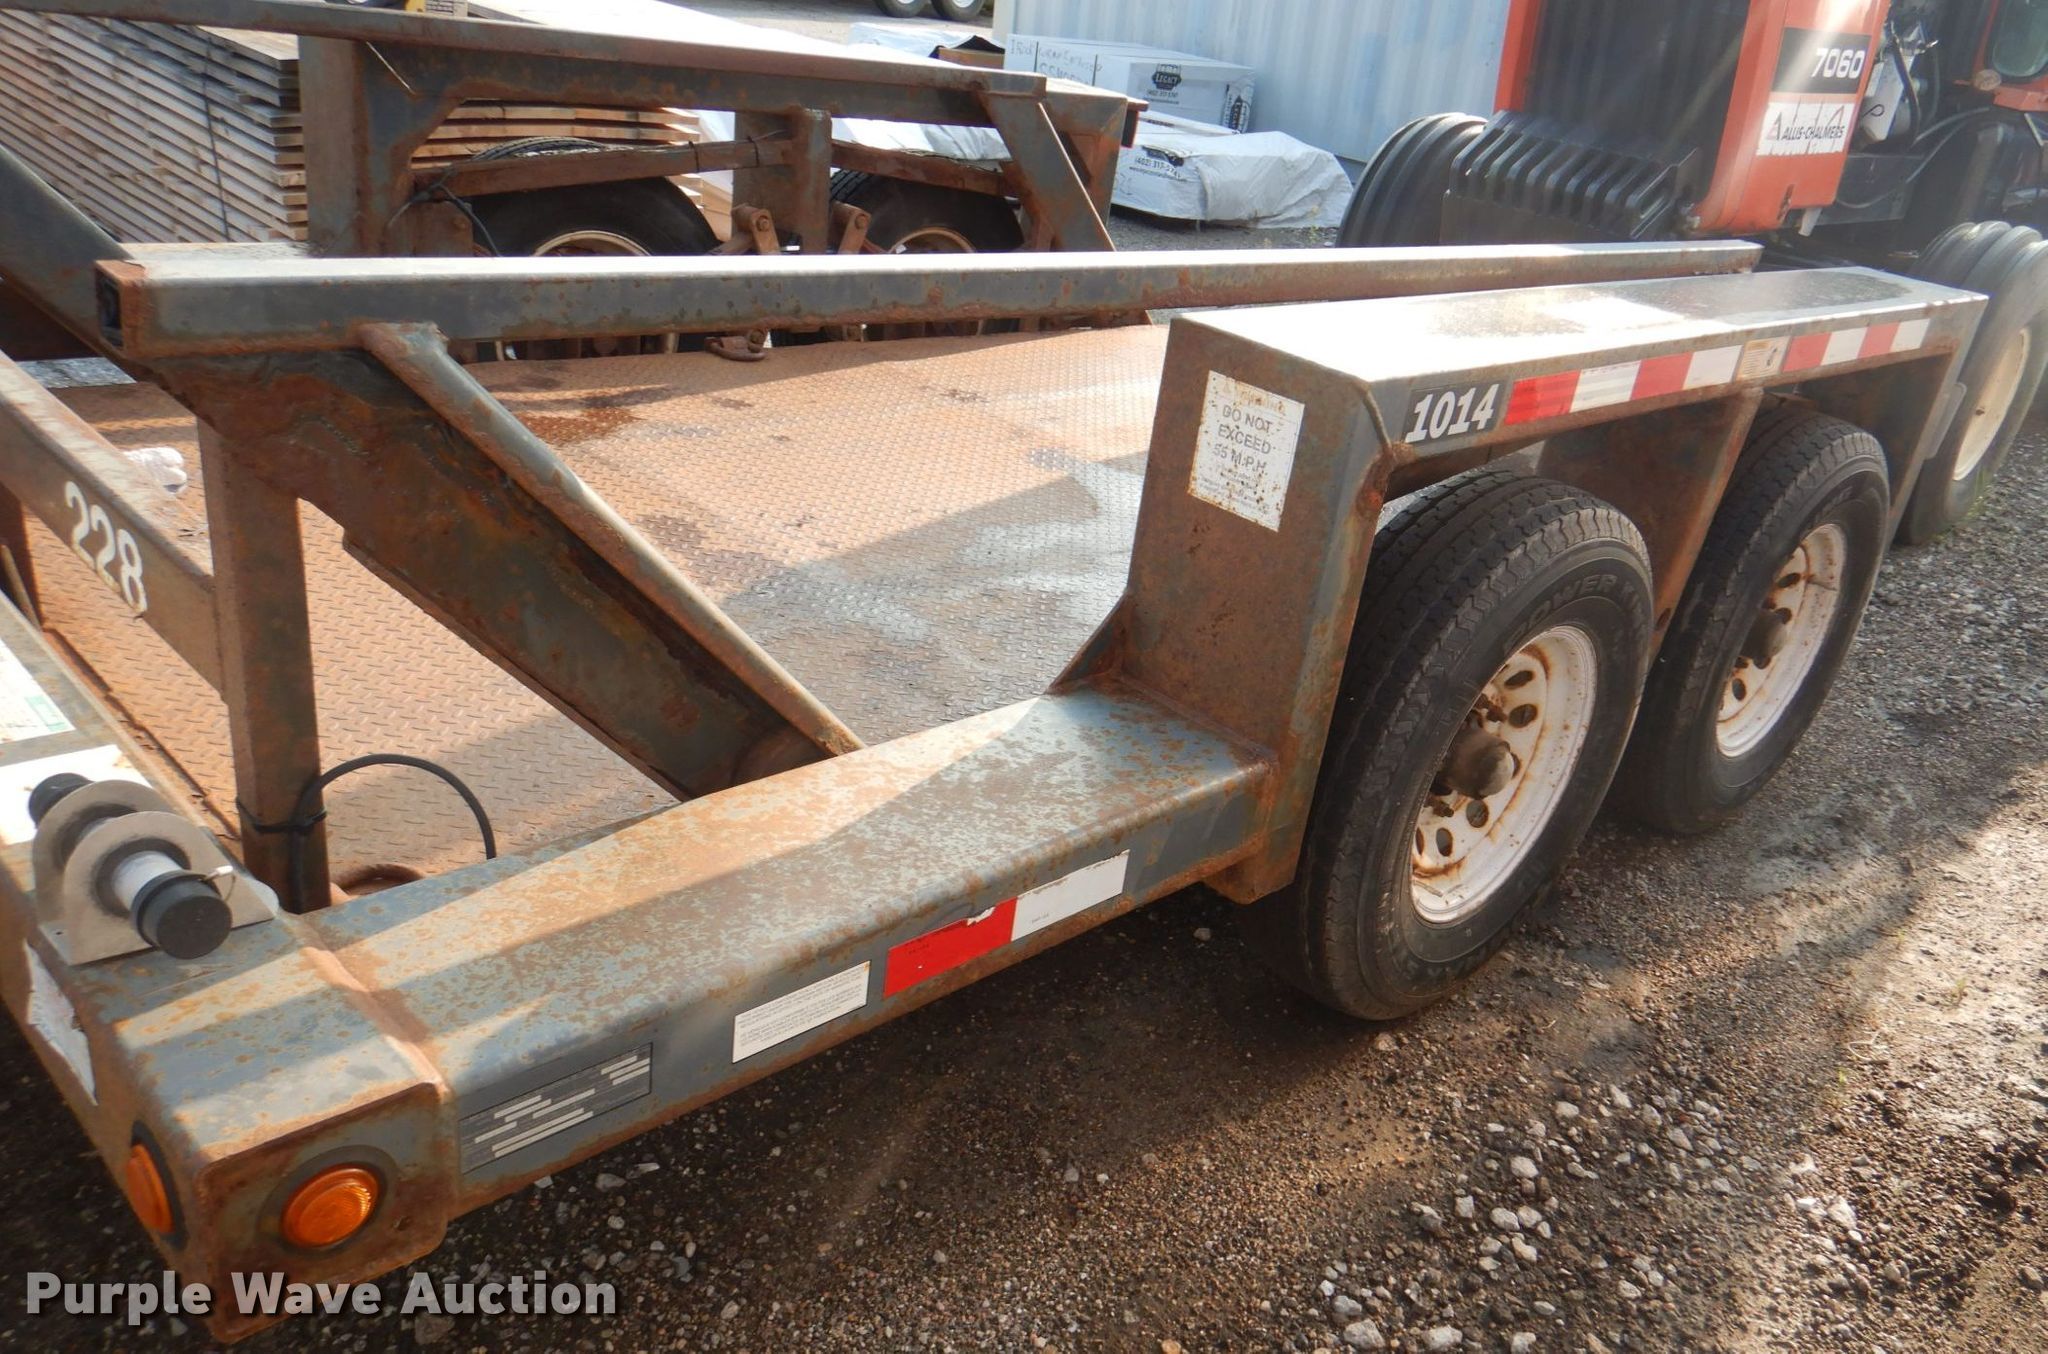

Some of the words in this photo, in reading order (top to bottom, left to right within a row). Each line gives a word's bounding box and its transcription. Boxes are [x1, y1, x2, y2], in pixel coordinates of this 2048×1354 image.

[1811, 48, 1865, 78] 7060
[1781, 125, 1845, 140] ALLIS-CHALMERS
[1222, 404, 1241, 422] DO
[1245, 413, 1273, 433] NOT
[1405, 384, 1499, 443] 1014
[1213, 442, 1228, 459] 55
[1218, 423, 1271, 454] EXCEED
[65, 480, 147, 613] 228
